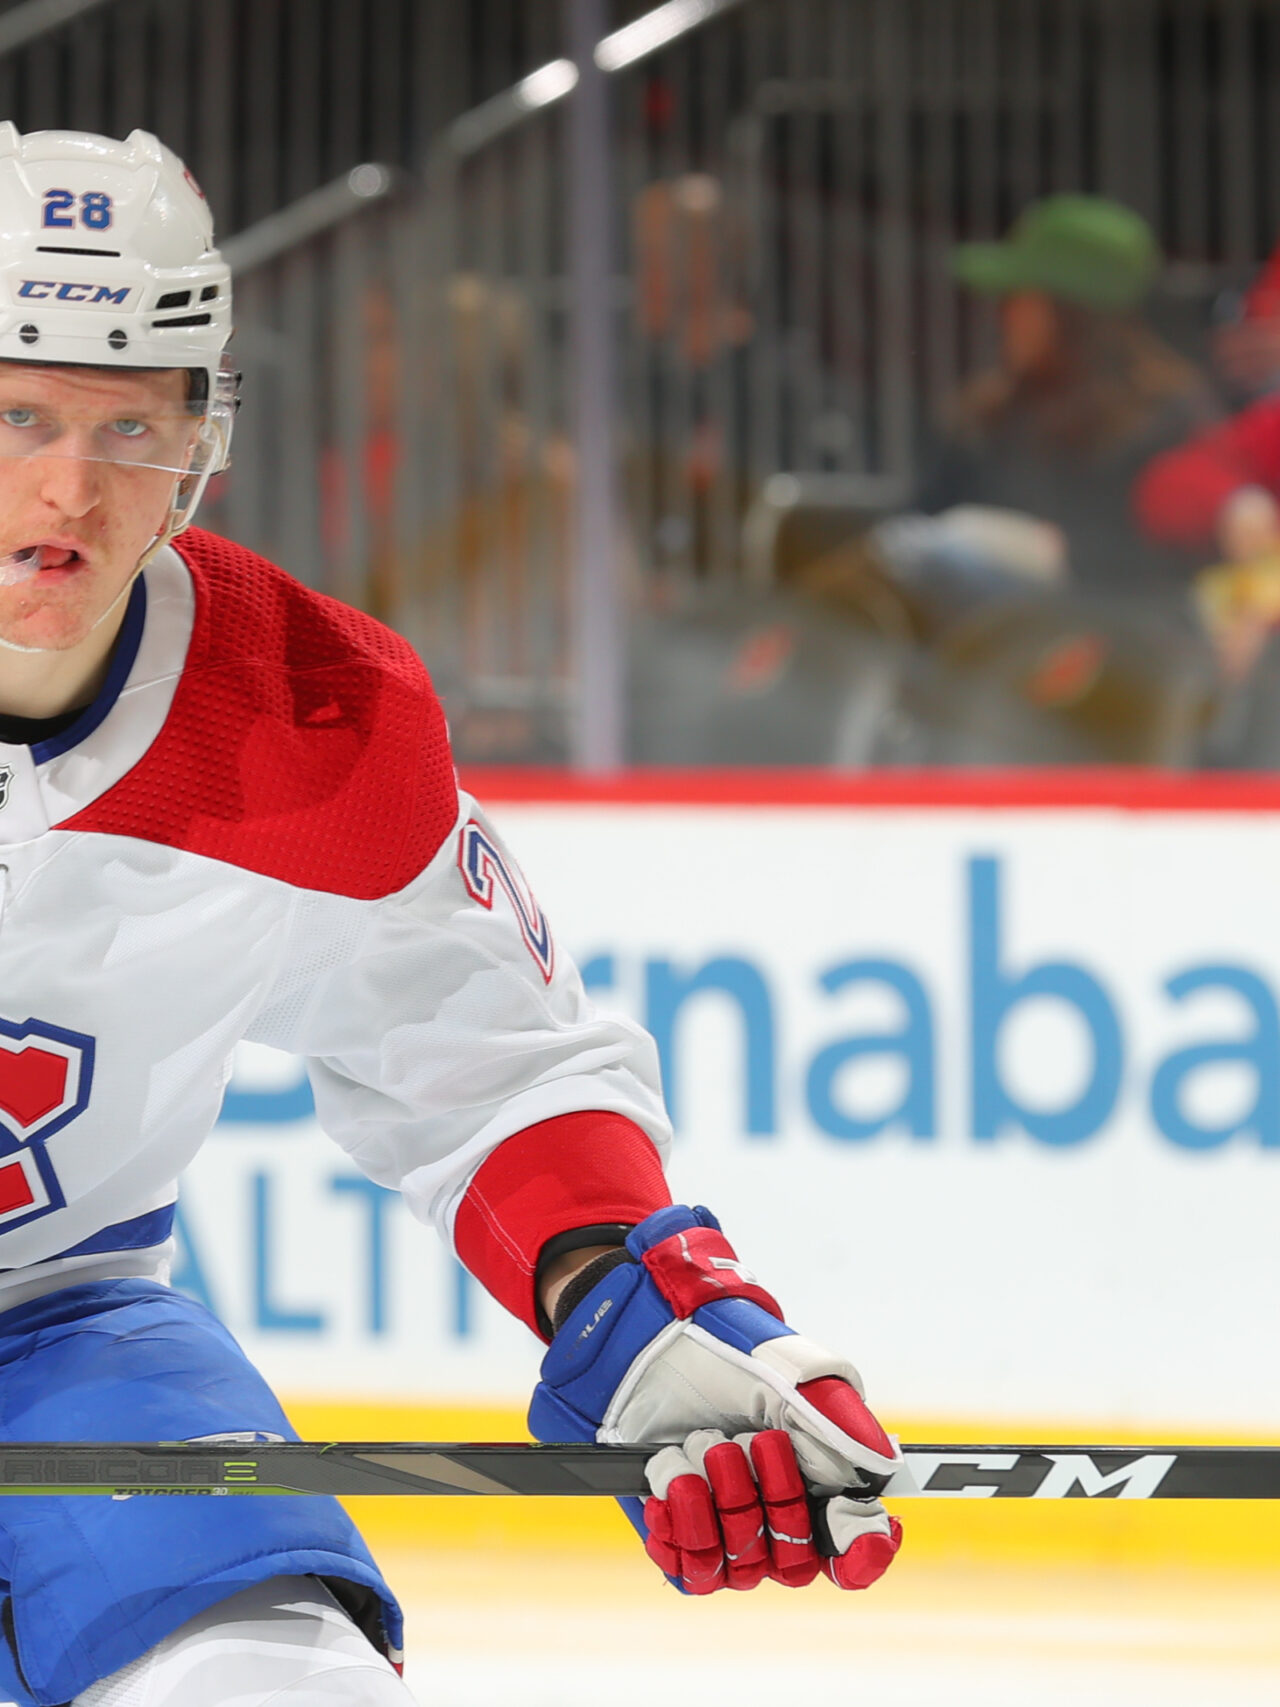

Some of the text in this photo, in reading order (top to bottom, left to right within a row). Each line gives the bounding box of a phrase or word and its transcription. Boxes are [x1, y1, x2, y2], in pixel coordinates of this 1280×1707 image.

[41, 187, 113, 232] 28
[17, 279, 132, 305] CCM
[580, 856, 1280, 1156] naba
[882, 1453, 1179, 1499] CM
